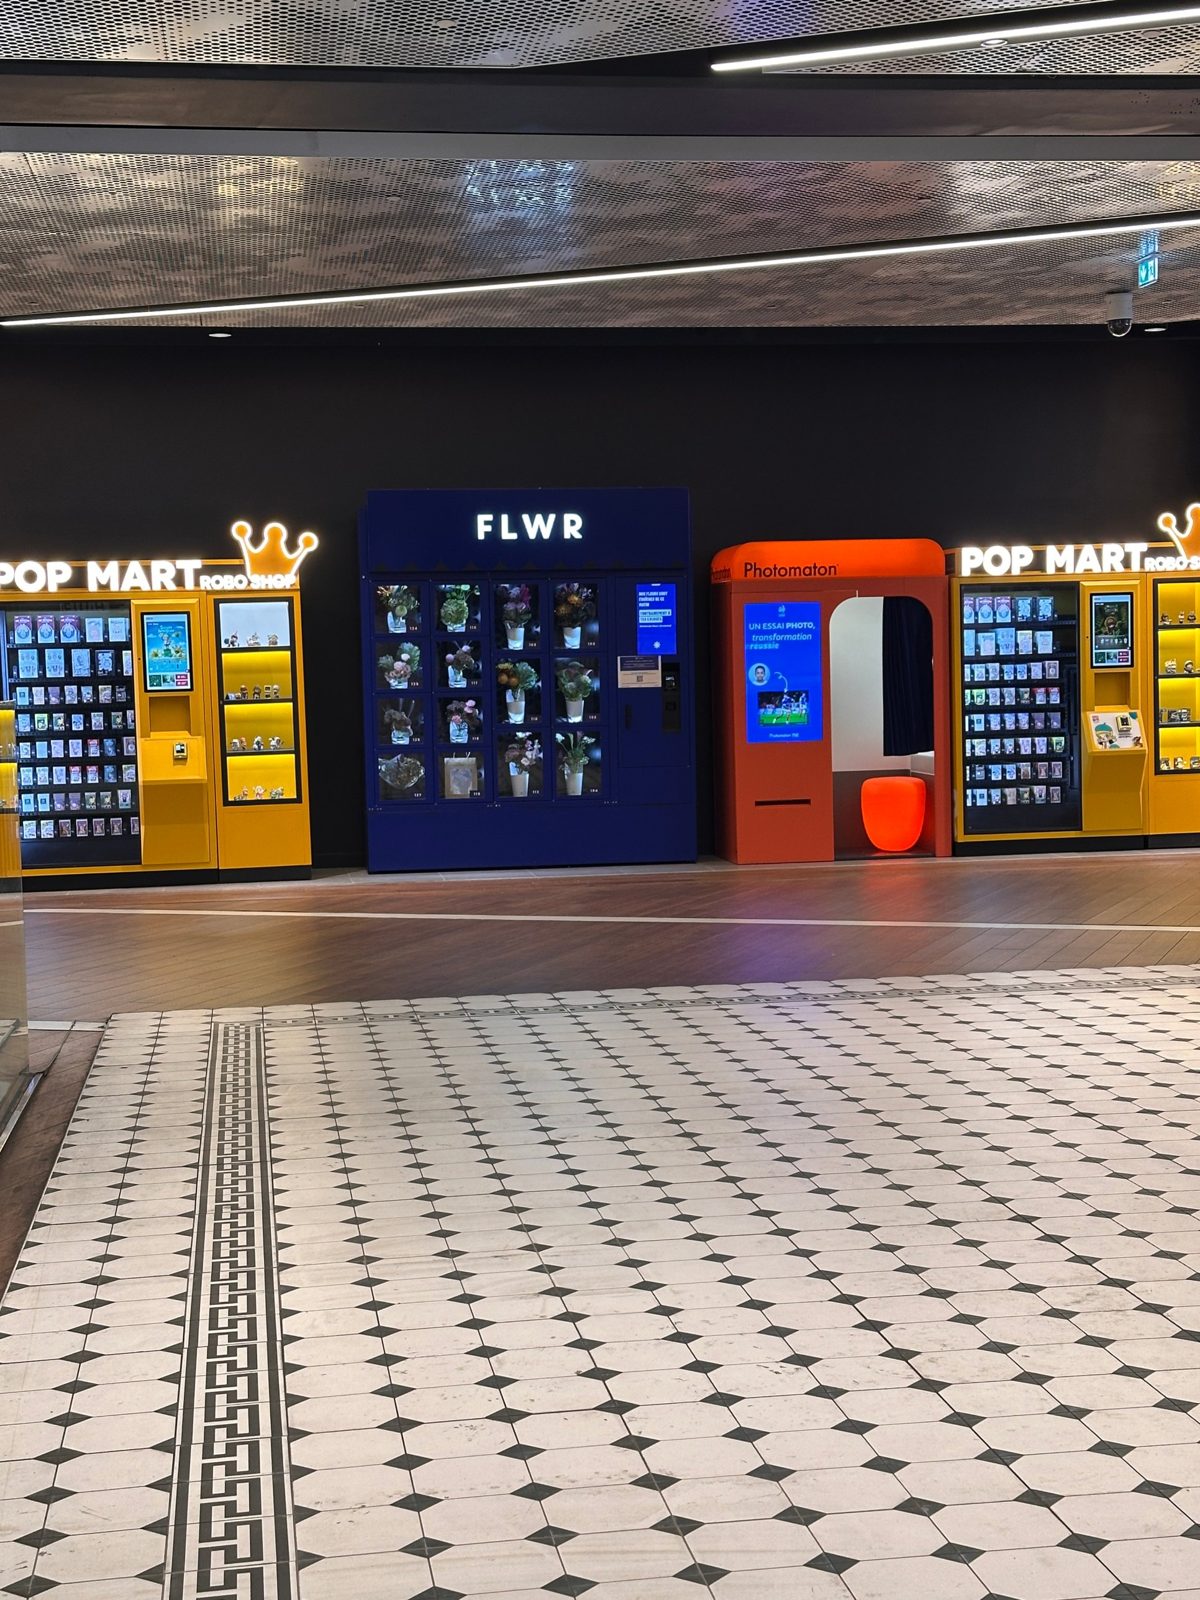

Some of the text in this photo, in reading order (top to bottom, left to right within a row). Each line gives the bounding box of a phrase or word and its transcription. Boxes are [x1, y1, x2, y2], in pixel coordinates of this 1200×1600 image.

[476, 513, 583, 540] FLWR
[743, 561, 838, 578] Photomaton
[961, 545, 1034, 577] POP
[1046, 543, 1148, 574] MART
[1144, 555, 1187, 571] ROBO
[0, 559, 296, 593] POP MART ROBO SHOP
[752, 632, 812, 641] transformation
[762, 622, 784, 630] ESSAI
[786, 621, 816, 630] PHOTO,
